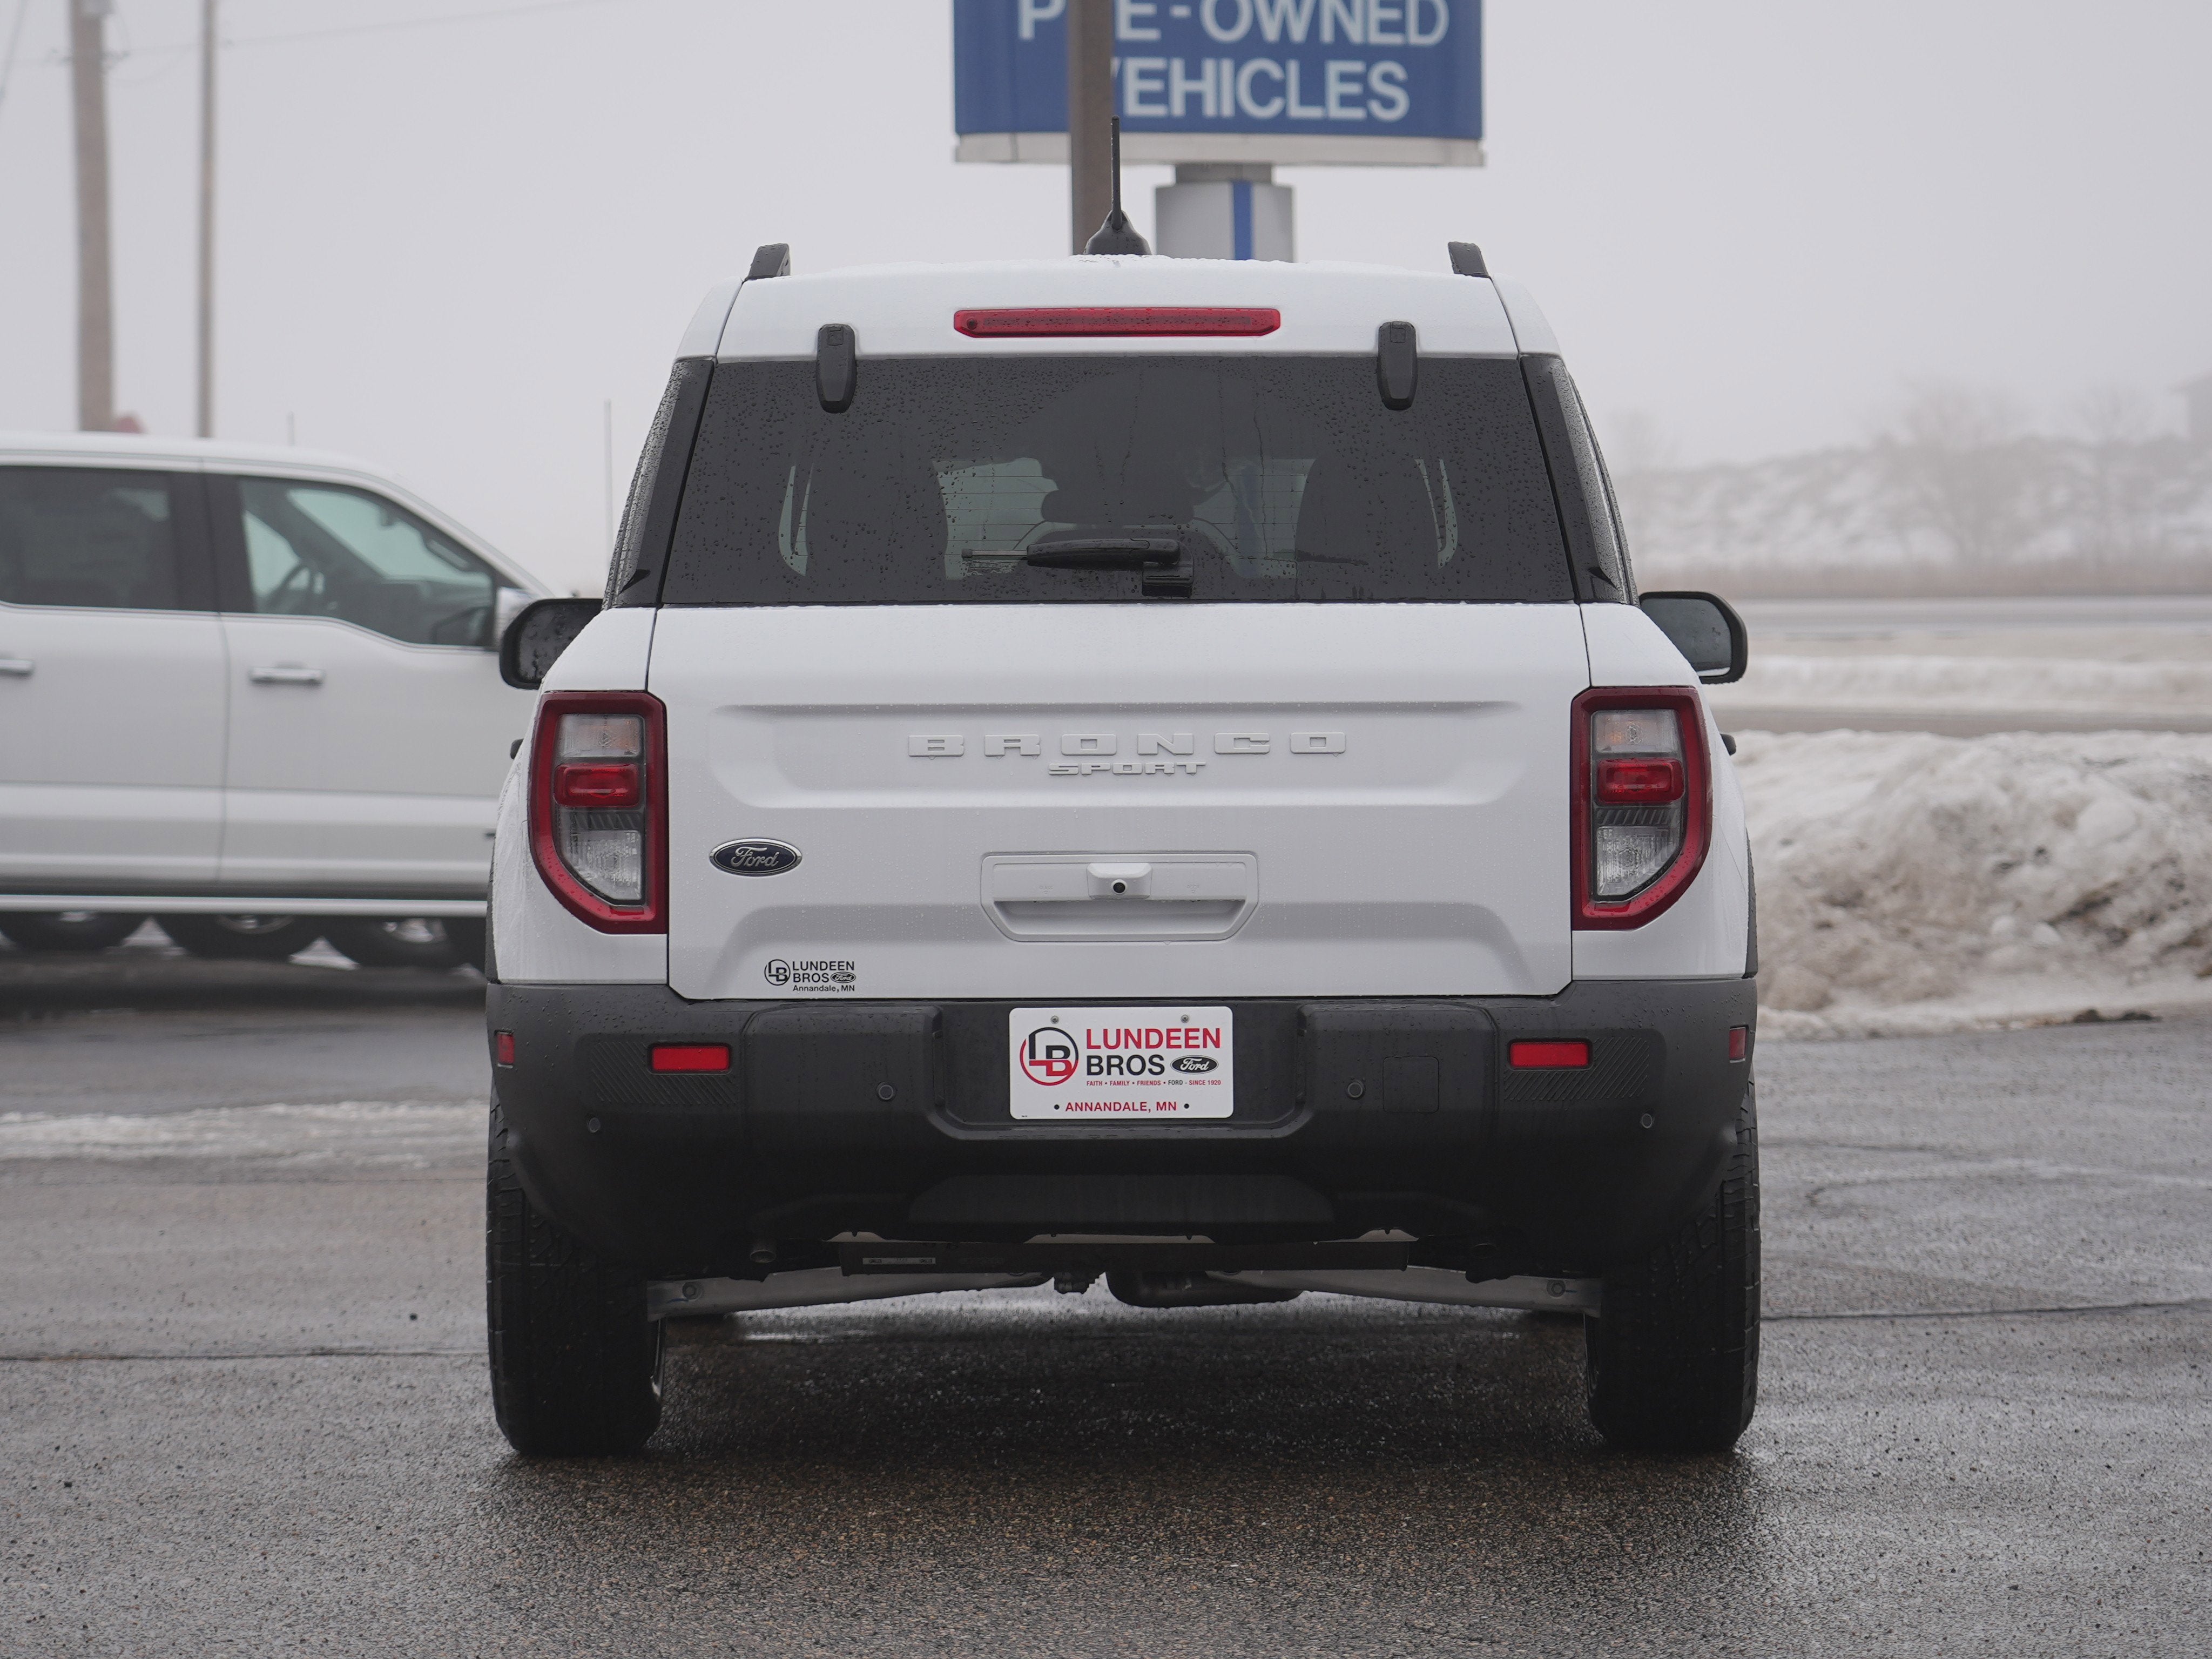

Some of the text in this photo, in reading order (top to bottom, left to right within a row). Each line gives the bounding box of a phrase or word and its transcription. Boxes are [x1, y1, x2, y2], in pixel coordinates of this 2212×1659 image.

[1018, 0, 1449, 45] PE-OWNED
[1112, 56, 1411, 122] EHICLES
[908, 732, 1347, 757] BRONCO
[1048, 762, 1207, 775] SPORT
[731, 846, 780, 867] Ford
[792, 961, 854, 971] LUNDEEN
[793, 973, 830, 983] BROS
[793, 984, 839, 993] Annandale,
[1087, 1028, 1220, 1049] LUNDEEN
[1087, 1055, 1210, 1076] BROS Ford
[1065, 1102, 1177, 1112] ANNANDALE, MN
